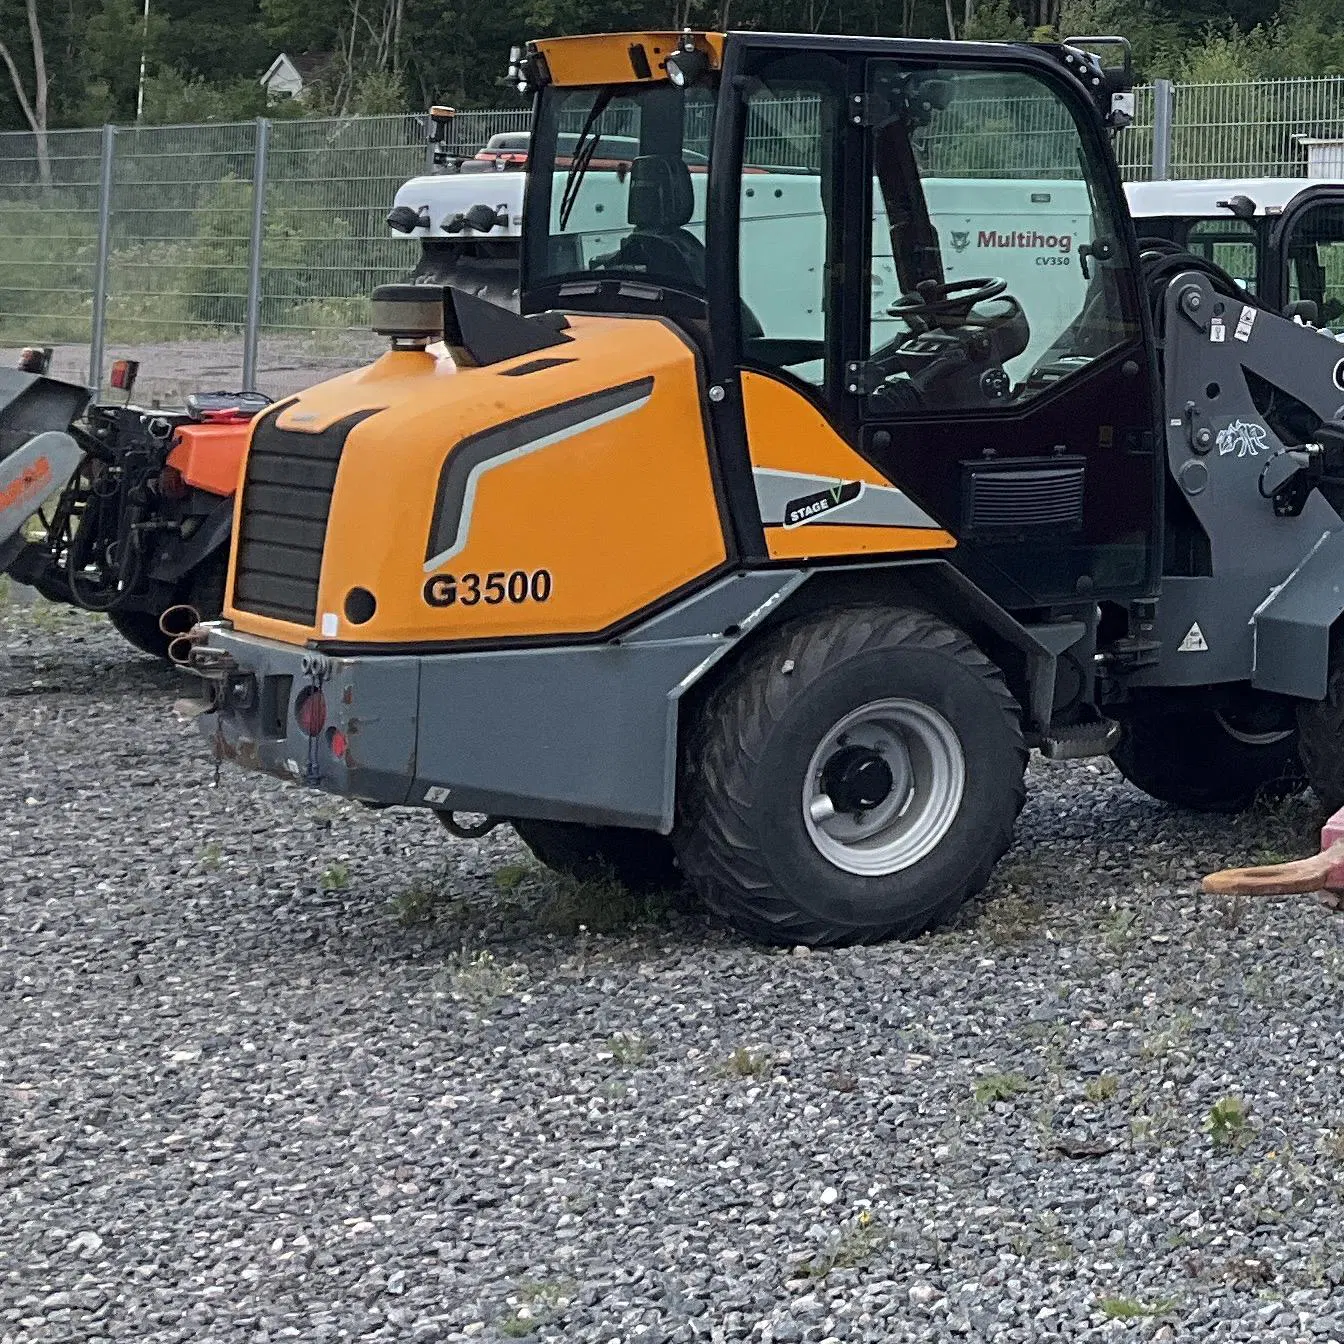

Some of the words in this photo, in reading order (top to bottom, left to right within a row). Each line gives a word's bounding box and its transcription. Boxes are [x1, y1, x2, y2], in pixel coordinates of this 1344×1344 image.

[977, 231, 1072, 253] Multihog
[1035, 257, 1070, 266] CV350
[790, 498, 829, 522] STAGE
[422, 569, 553, 607] G3500
